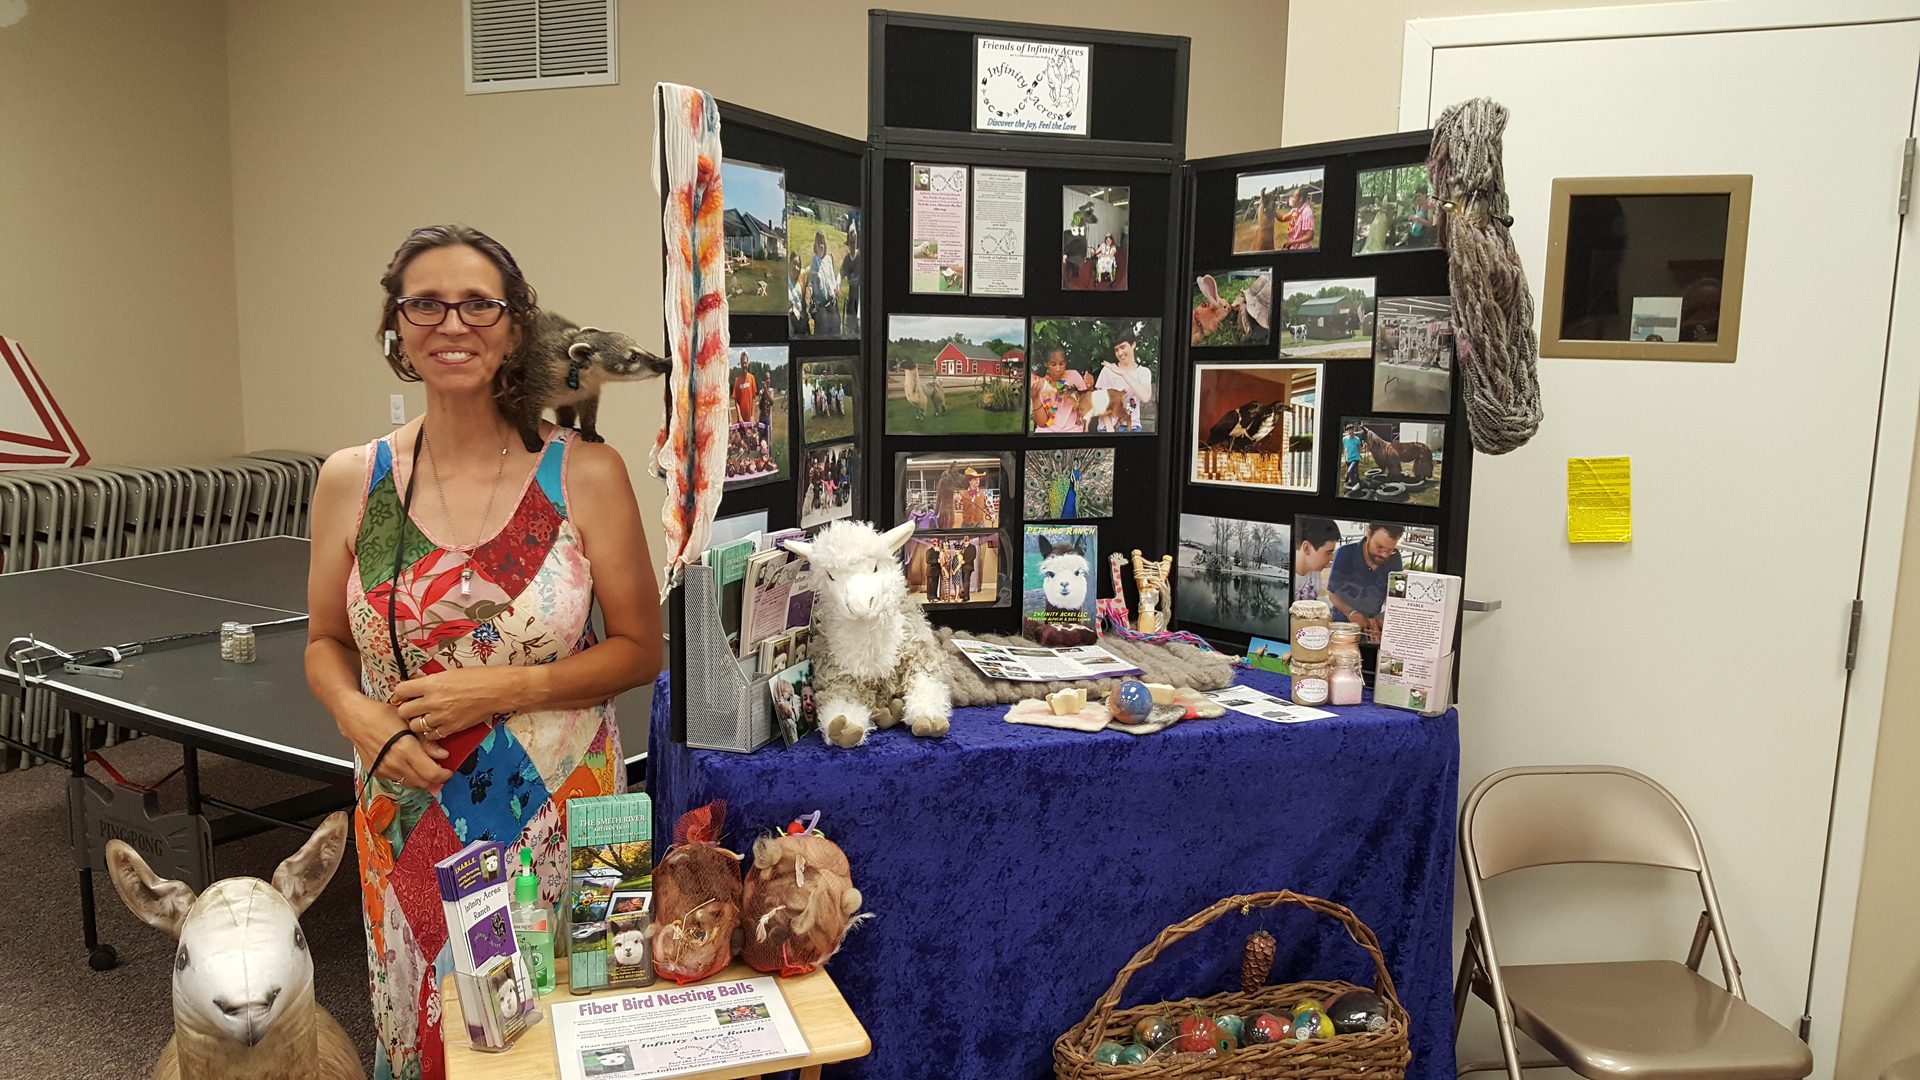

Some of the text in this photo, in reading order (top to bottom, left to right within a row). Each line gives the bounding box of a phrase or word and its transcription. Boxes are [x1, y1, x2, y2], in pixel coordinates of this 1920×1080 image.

[982, 40, 1014, 51] Friends
[1016, 43, 1026, 54] of
[1027, 44, 1059, 57] Infinity
[1060, 47, 1084, 56] Acres
[987, 61, 1028, 89] Infinity
[1029, 96, 1057, 120] Acres
[987, 117, 1014, 128] Discover
[1015, 119, 1025, 128] the
[1025, 120, 1037, 130] Joy,
[1038, 121, 1051, 129] Feel
[1062, 123, 1077, 131] Love
[1026, 526, 1096, 535] PETTING RANCH
[580, 814, 646, 827] THE SMITH RIVER
[464, 886, 501, 913] Infinity Acres
[473, 905, 491, 920] Ranch
[578, 1002, 619, 1016] Fiber
[621, 993, 654, 1011] Bird
[657, 989, 717, 1006] Nesting
[717, 982, 754, 997] Balls
[641, 1026, 765, 1048] Infinity Acres Ranch
